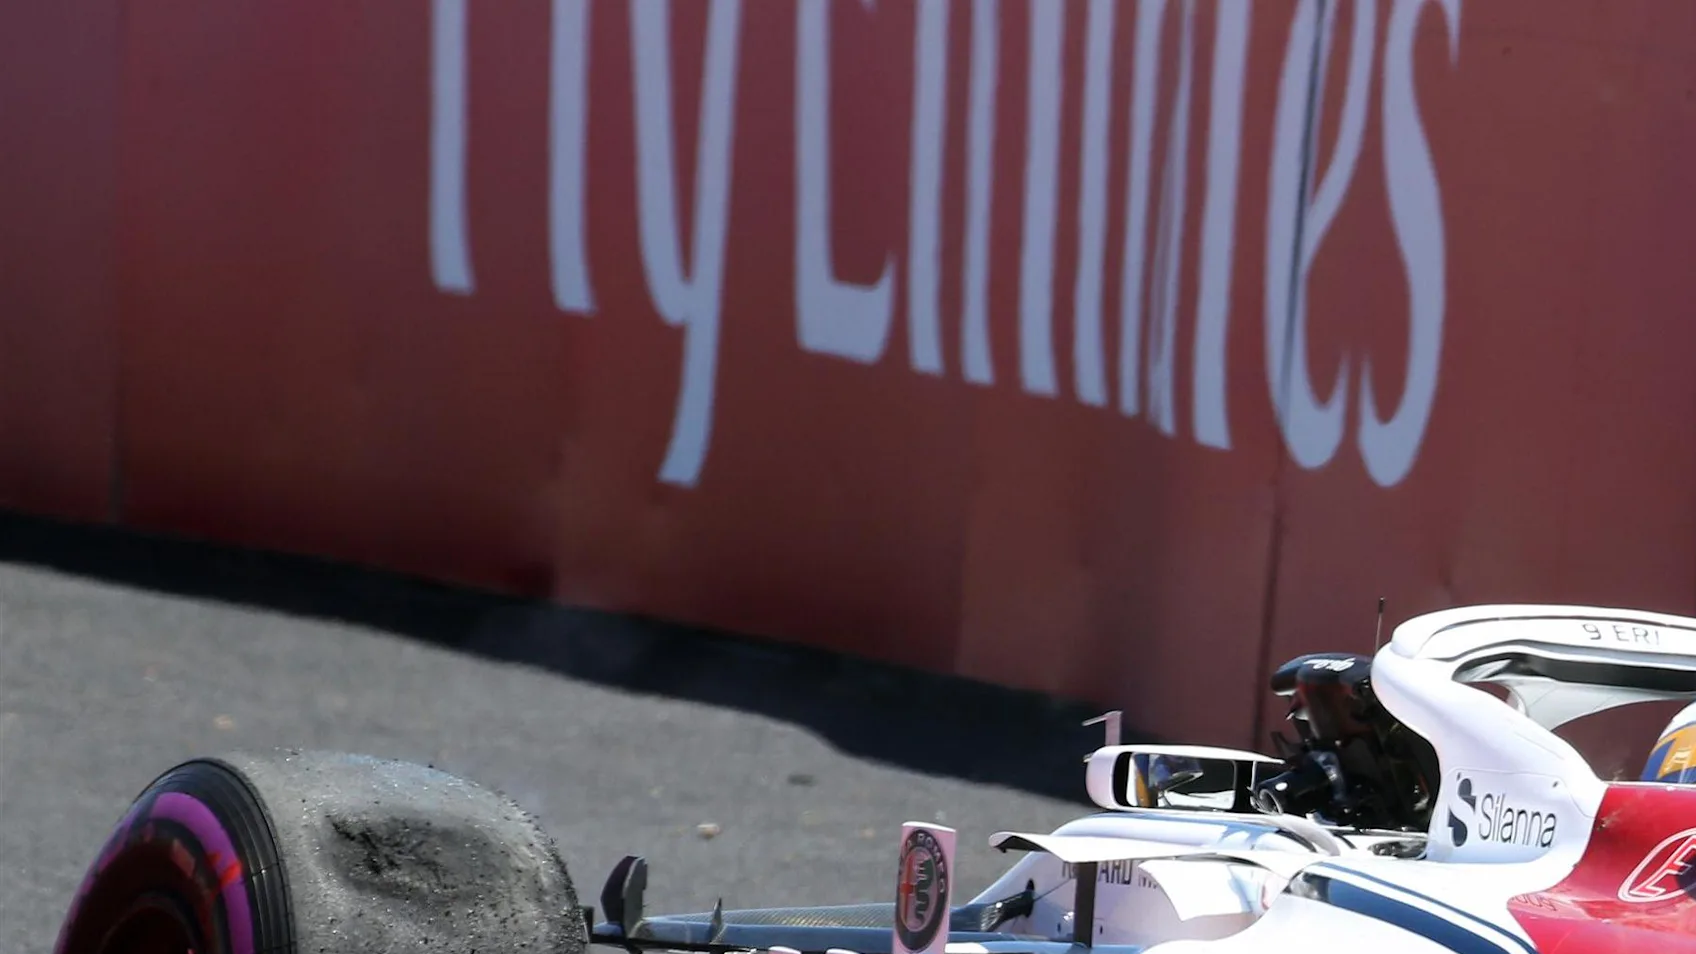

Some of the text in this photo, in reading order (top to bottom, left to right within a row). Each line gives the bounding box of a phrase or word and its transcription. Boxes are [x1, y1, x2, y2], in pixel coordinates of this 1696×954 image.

[1582, 623, 1660, 645] 9 ERI
[1479, 793, 1557, 848] Silanna
